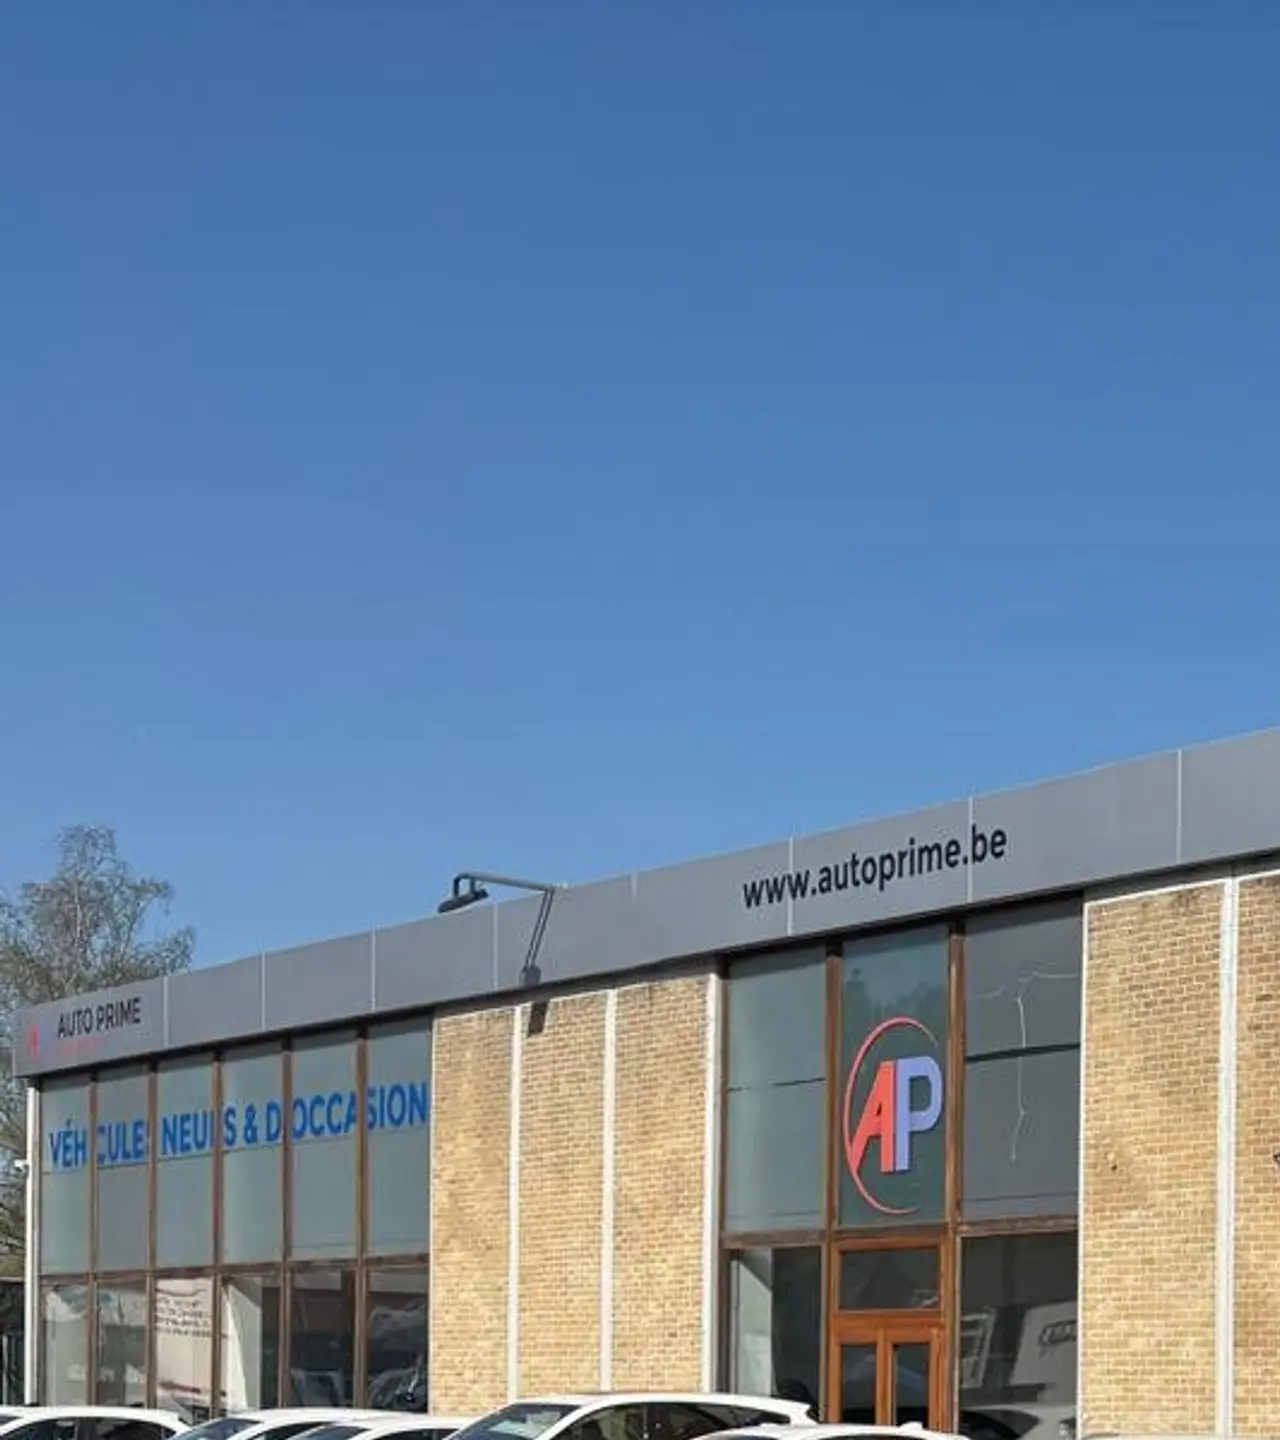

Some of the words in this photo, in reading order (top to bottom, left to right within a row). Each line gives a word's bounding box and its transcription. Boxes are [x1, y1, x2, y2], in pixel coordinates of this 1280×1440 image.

[742, 822, 1007, 909] www.autoprime.be
[57, 1009, 93, 1040] AUTO
[96, 997, 141, 1031] PRIME
[49, 1117, 150, 1168] VÉHCULE
[243, 1104, 258, 1145] &
[266, 1081, 428, 1143] DOCCASION
[851, 1055, 943, 1174] AP
